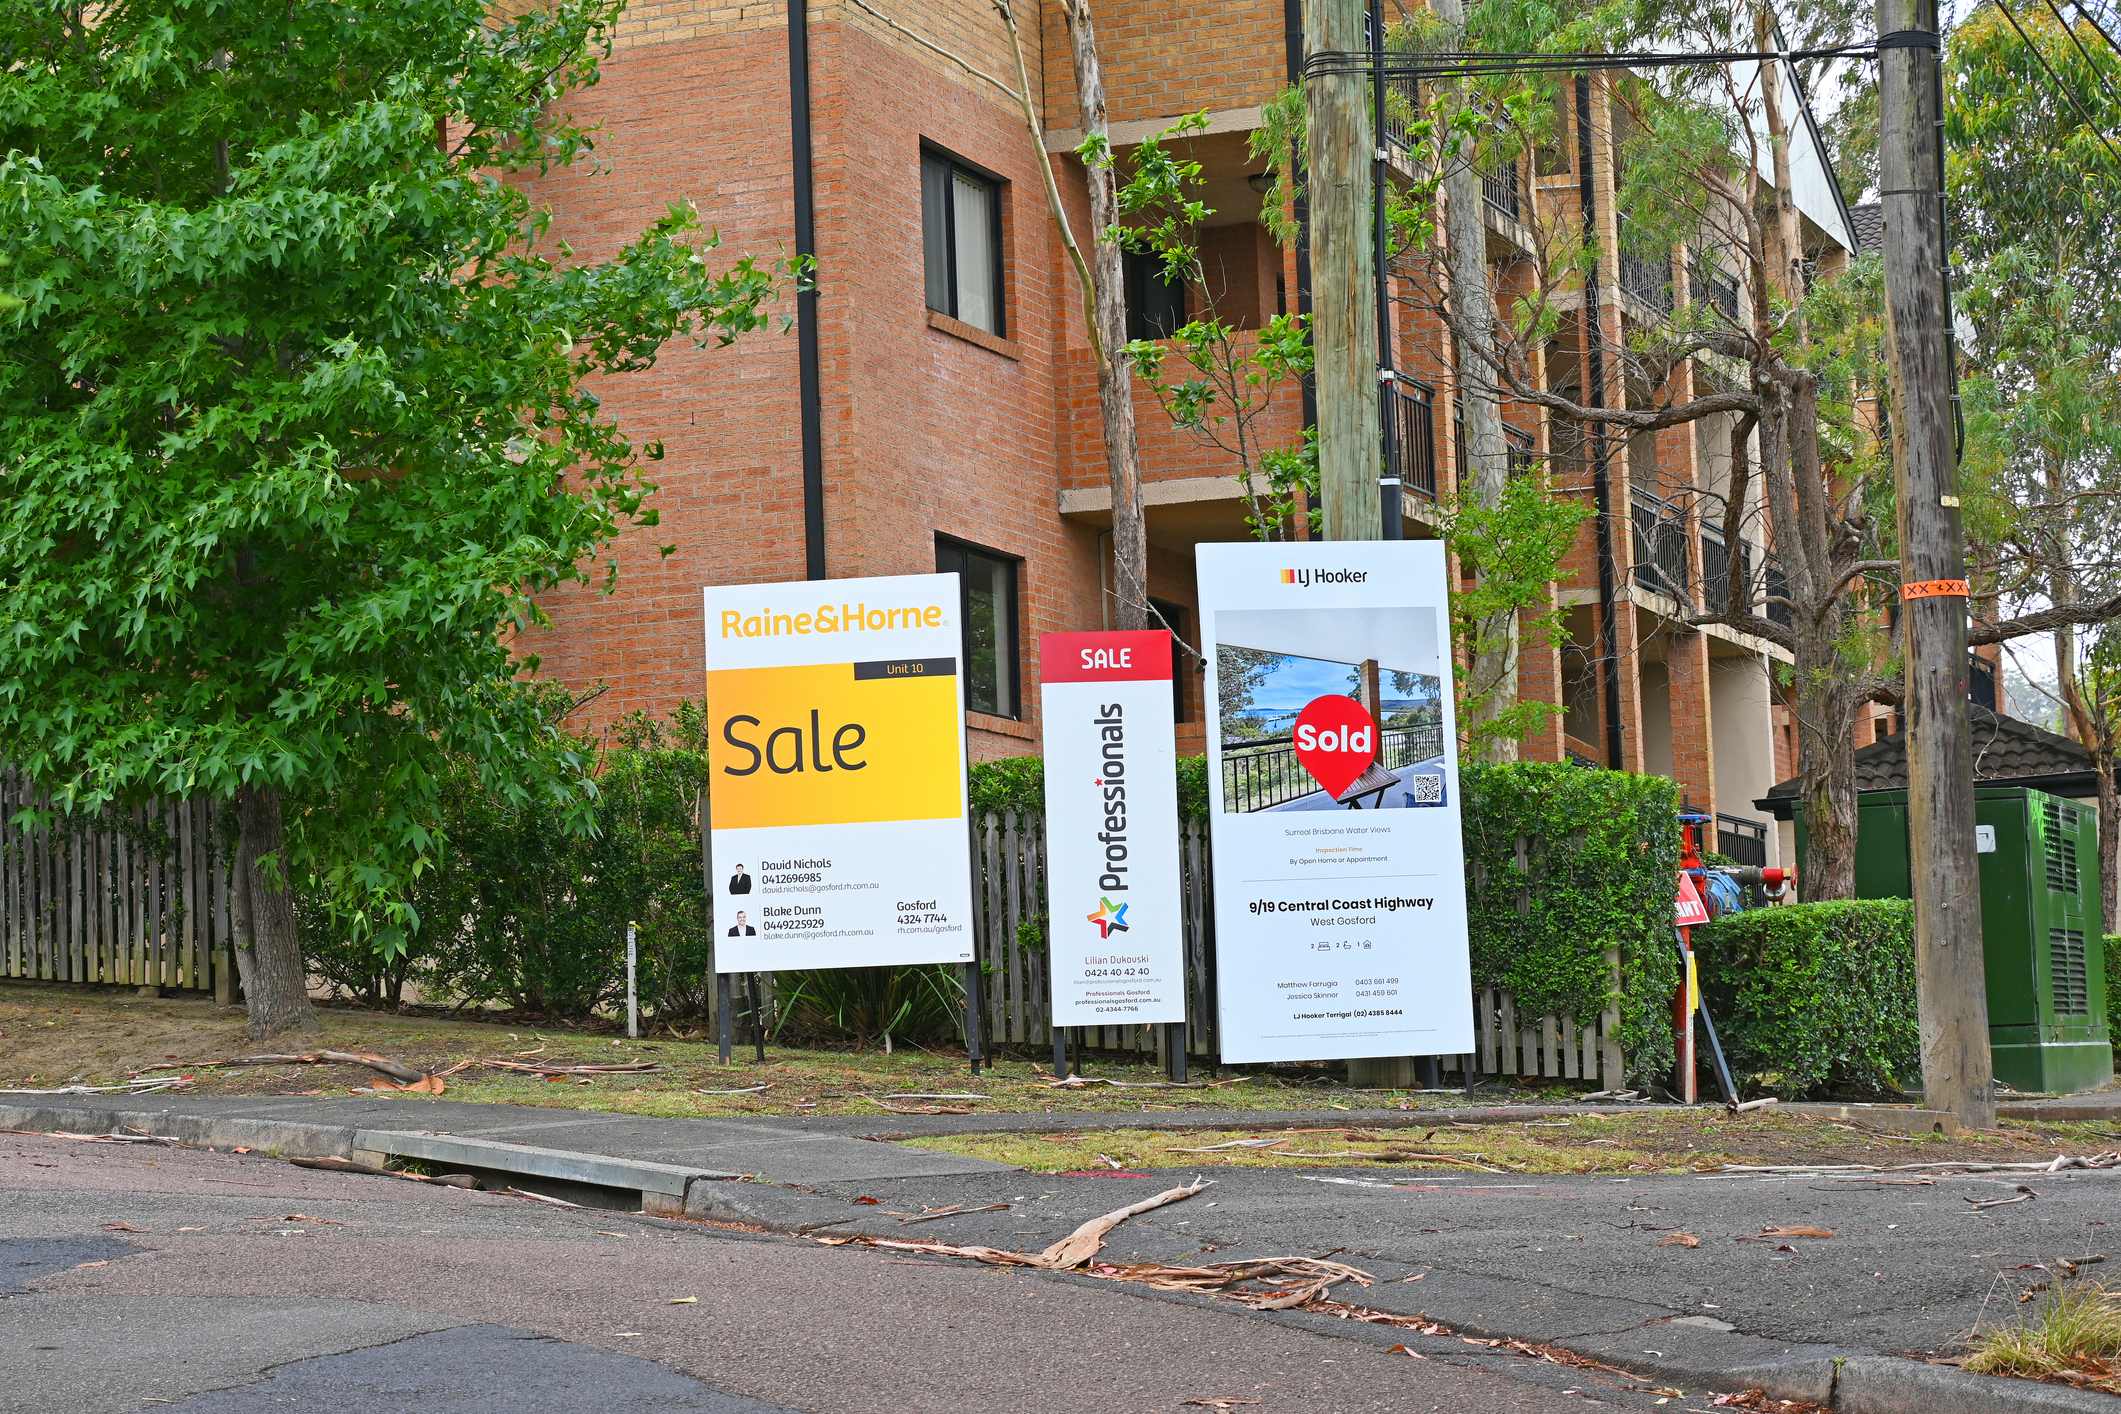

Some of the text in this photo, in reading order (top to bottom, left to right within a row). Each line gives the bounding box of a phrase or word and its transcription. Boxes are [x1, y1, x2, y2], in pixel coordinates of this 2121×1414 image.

[1298, 568, 1368, 587] LJ Hooker
[1081, 648, 1132, 670] SALE
[887, 663, 924, 675] Unit 10
[723, 709, 868, 777] Sale
[1297, 724, 1372, 754] Sold
[1093, 703, 1129, 891] Professionals
[1284, 826, 1391, 836] Surreal Brisbane Water Views
[761, 858, 832, 871] David Nichols
[1289, 858, 1298, 866] By
[1298, 858, 1317, 866] Open
[1346, 856, 1388, 864] Appointment
[762, 873, 822, 884] 0412696985
[762, 883, 880, 894] david.nichols@gosford.rh.com.au
[896, 899, 937, 911] Gosford
[1249, 896, 1434, 915] 9/19 Central Coast Highway
[763, 905, 822, 917] Blake Dunn
[763, 918, 825, 930] 0449225929
[897, 913, 948, 925] 4324 7744
[1310, 915, 1376, 926] West Gosford
[764, 929, 874, 940] blake.dunn@gosford.rh.com.au
[897, 924, 962, 934] rh.com.au/gosford
[1085, 955, 1149, 965] Lilian Dukovski
[1084, 967, 1150, 977] 0424 40 42 40
[1277, 981, 1308, 989] Matthew
[1309, 980, 1338, 989] Farrugia
[1075, 998, 1161, 1006] professionalsgosford.com.au
[1326, 1011, 1352, 1019] Terrigal
[1353, 1009, 1367, 1018] (02)
